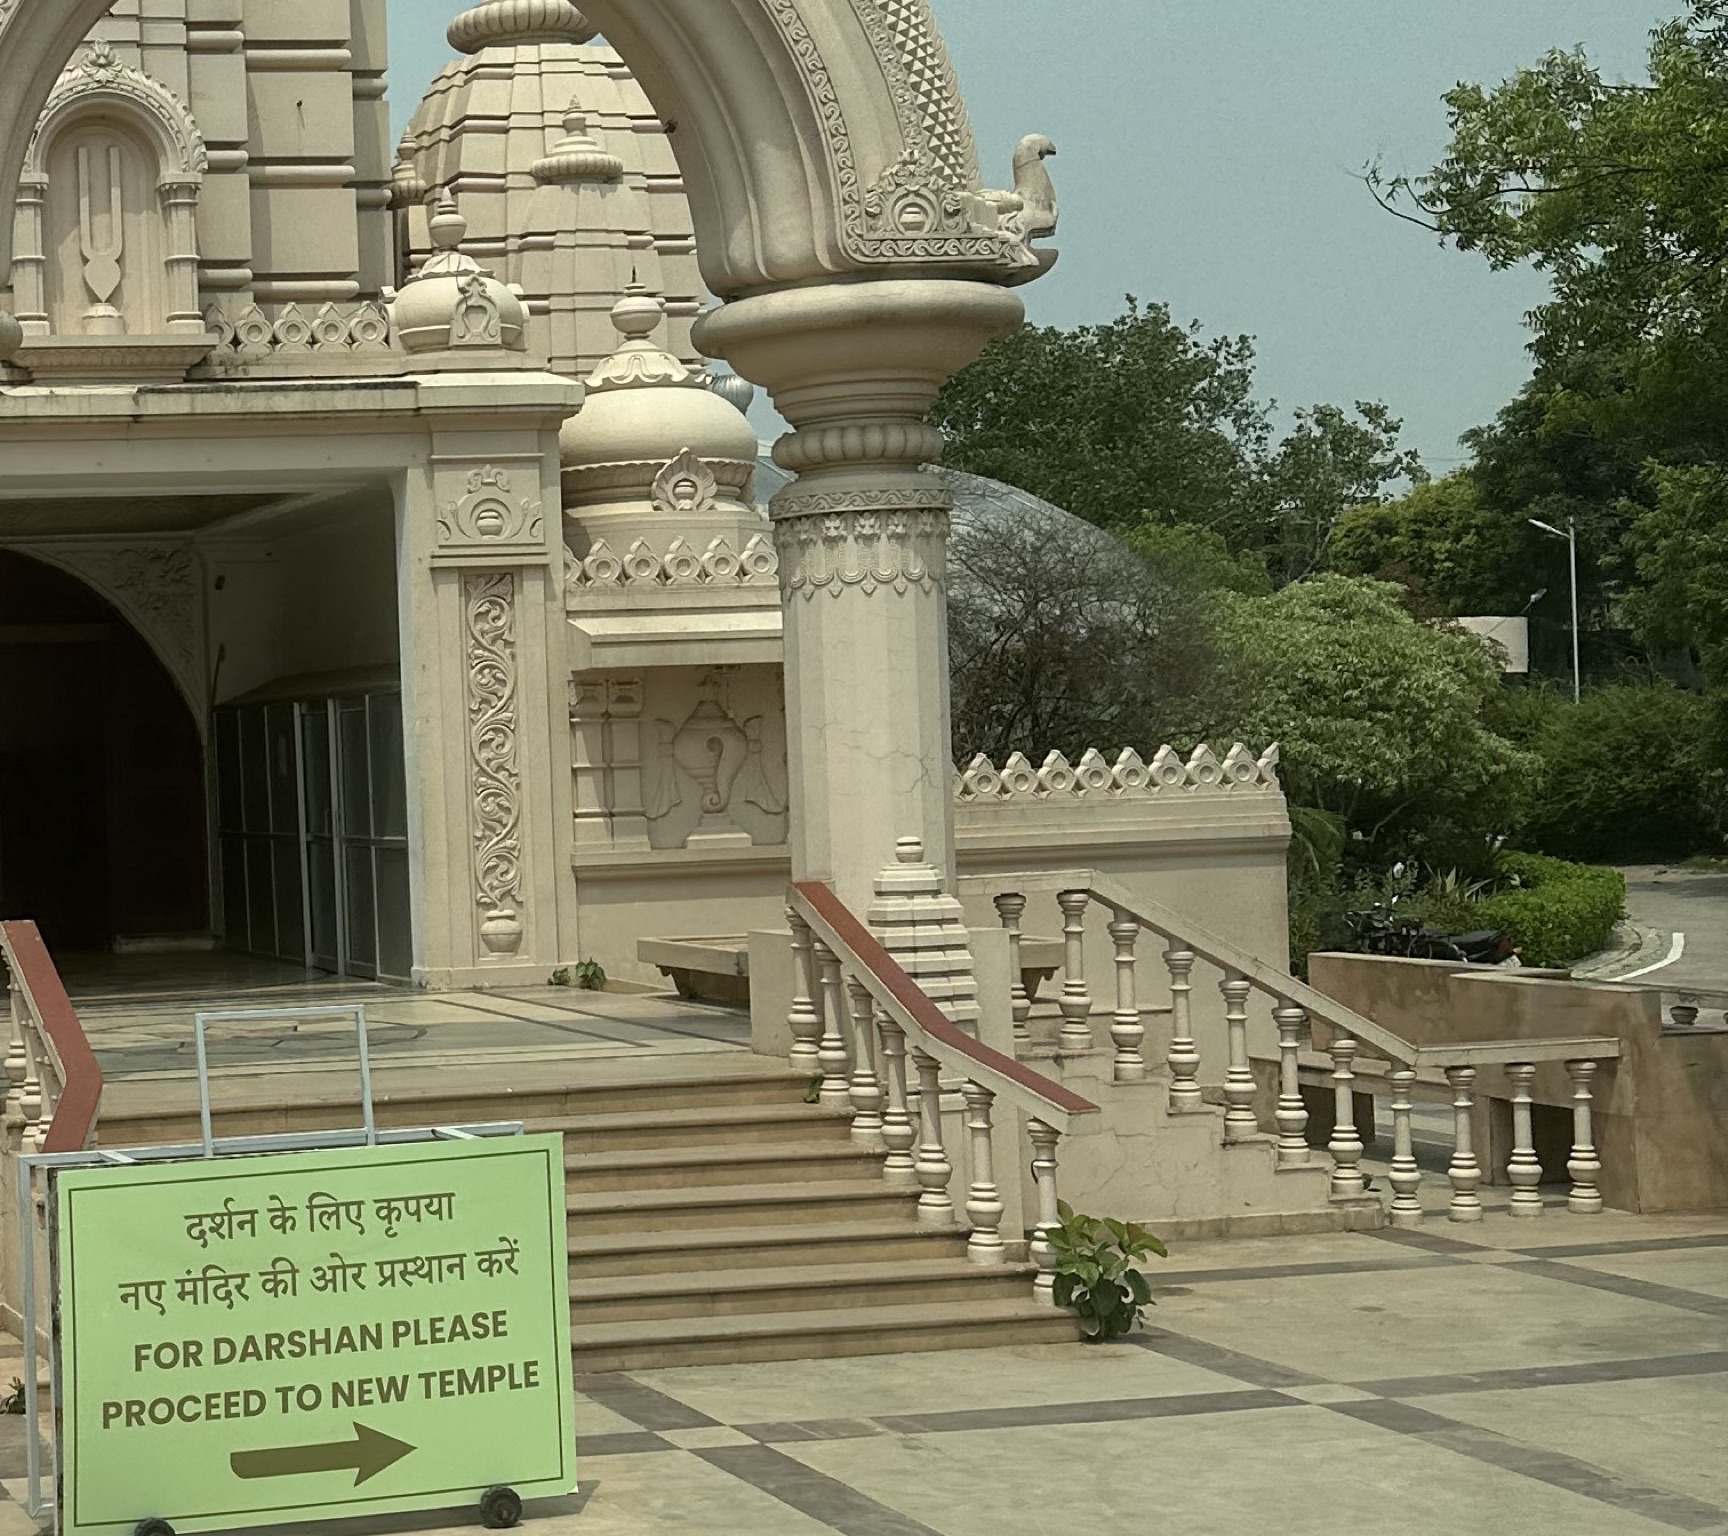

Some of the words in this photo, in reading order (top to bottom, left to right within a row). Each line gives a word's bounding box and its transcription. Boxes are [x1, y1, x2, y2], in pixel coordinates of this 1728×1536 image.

[184, 1197, 259, 1248] दर्शन
[267, 1194, 298, 1234] के
[306, 1192, 366, 1236] लिए
[373, 1192, 456, 1238] कृपया
[118, 1280, 167, 1316] नए
[175, 1264, 250, 1310] मंदिर
[258, 1256, 300, 1298] की
[310, 1252, 367, 1293] ओर
[375, 1253, 467, 1287] प्रस्थान
[474, 1236, 520, 1277] करें
[135, 1340, 203, 1372] FOR
[213, 1322, 383, 1365] DARSHAN
[392, 1310, 508, 1348] PLEASE
[102, 1389, 266, 1429] PROCEED
[275, 1383, 322, 1414] TO
[332, 1374, 409, 1408] NEW
[418, 1360, 539, 1399] TEMPLE
